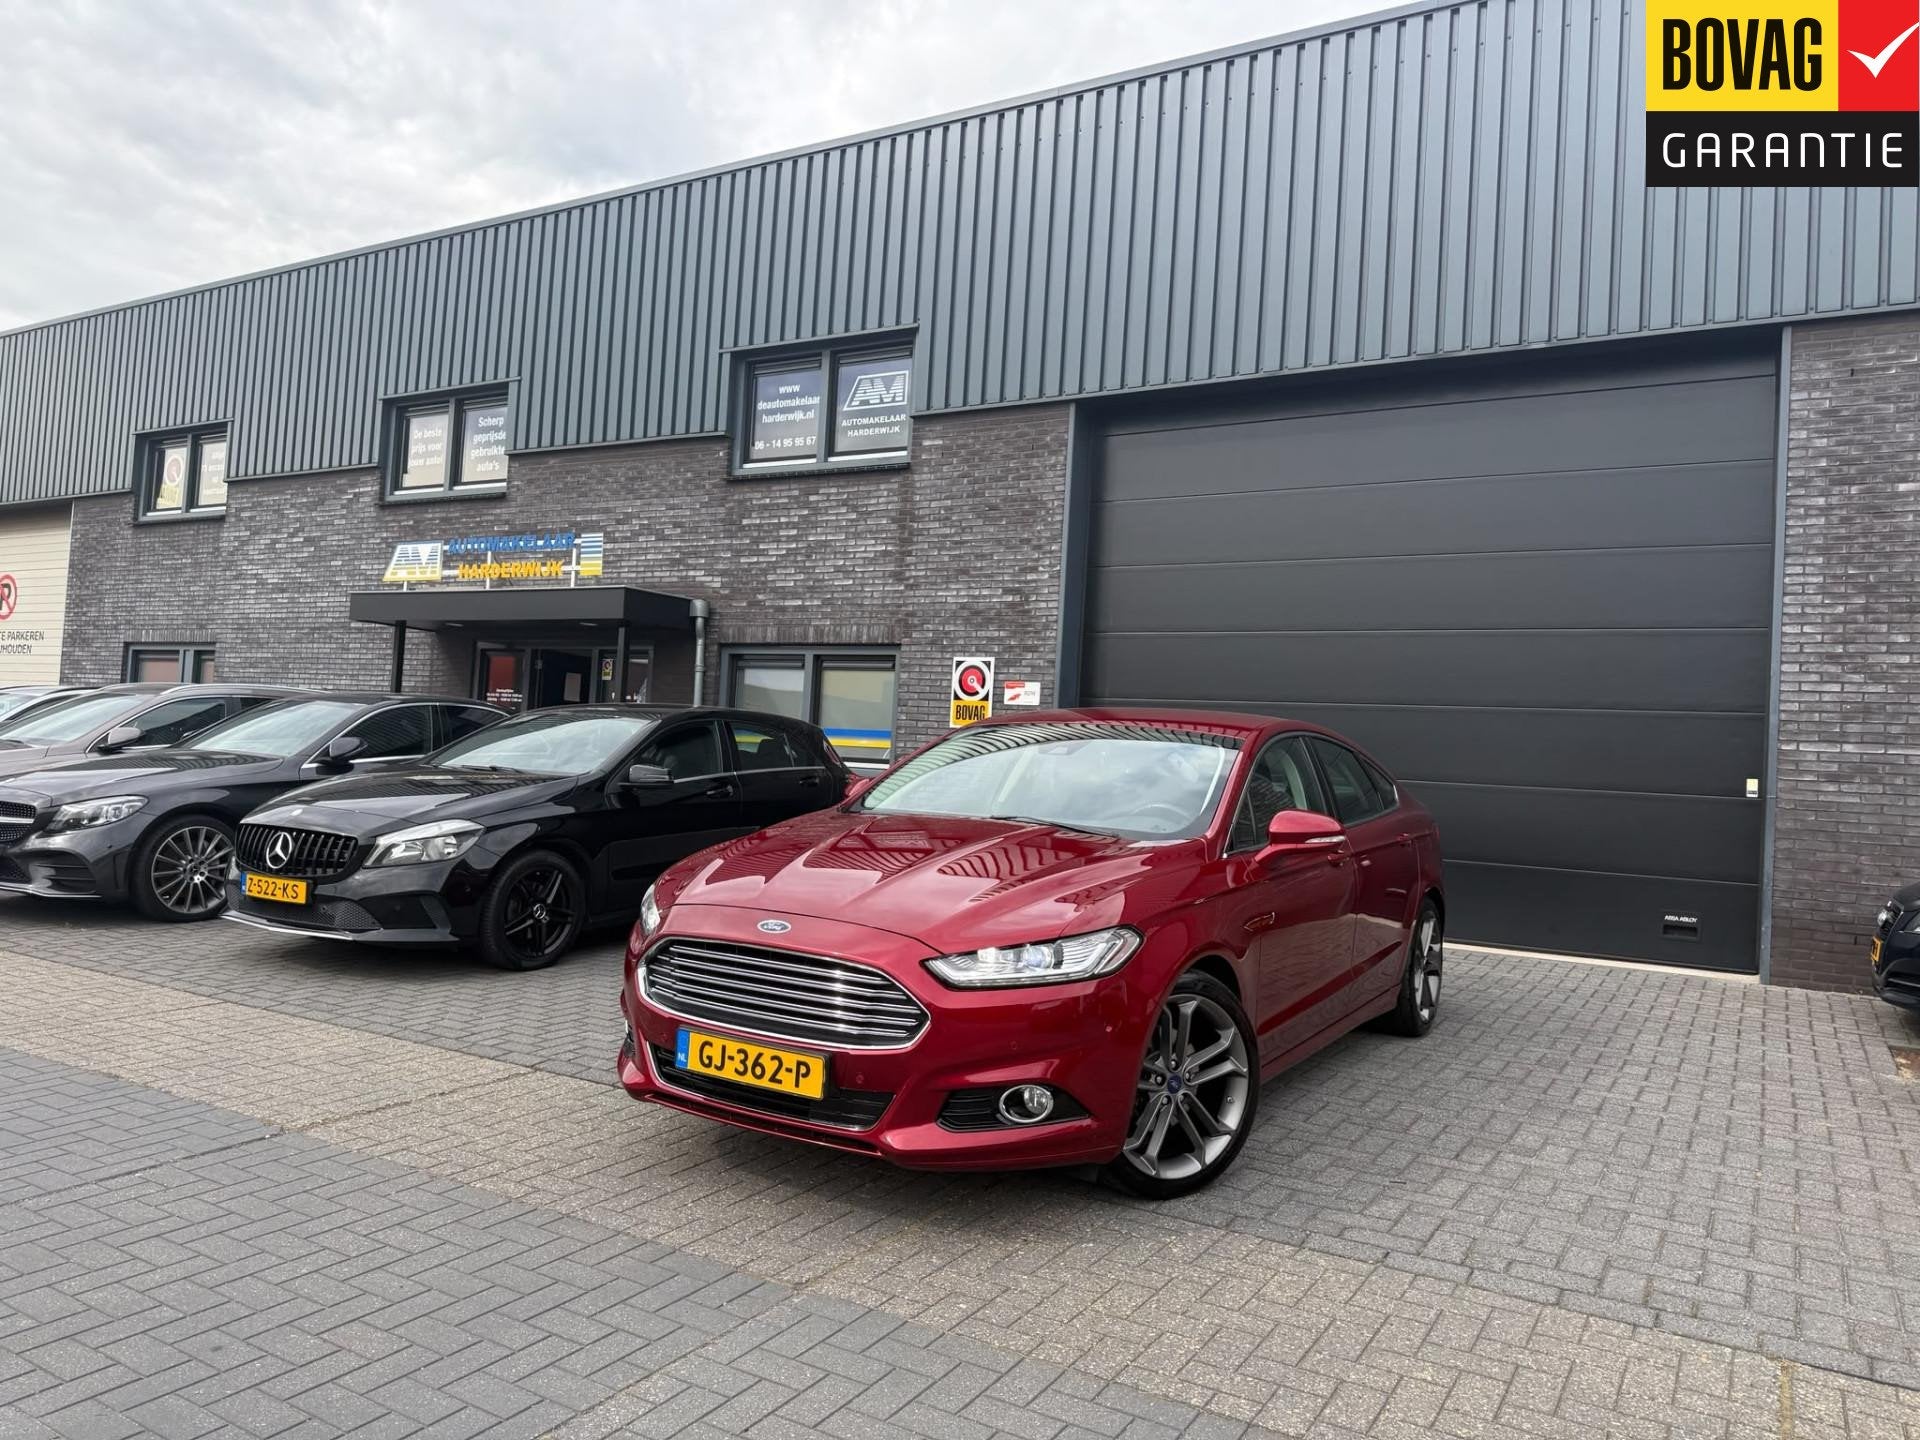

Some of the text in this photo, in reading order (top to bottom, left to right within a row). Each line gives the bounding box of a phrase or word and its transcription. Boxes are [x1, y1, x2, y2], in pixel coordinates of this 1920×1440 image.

[778, 384, 801, 394] www
[850, 375, 905, 406] AM
[757, 395, 820, 410] deautomakelaar
[478, 416, 505, 427] Scherp
[762, 409, 815, 423] harderwijk.nl
[841, 413, 906, 426] AUTOMAKELAAR
[847, 425, 901, 437] HARDERWIJK
[754, 440, 765, 450] 06
[772, 439, 781, 448] 14
[783, 438, 793, 447] 95
[794, 437, 804, 446] 95
[806, 436, 817, 445] 67
[476, 460, 500, 472] auto's
[448, 532, 575, 554] AUTOMAKELAAR
[458, 559, 564, 579] HARDERWIJK
[7, 631, 45, 641] PARKEREN
[955, 704, 986, 720] BOVAG
[247, 877, 299, 899] Z-522-KS
[677, 1052, 687, 1063] NL
[698, 1039, 811, 1088] GJ-362-P
